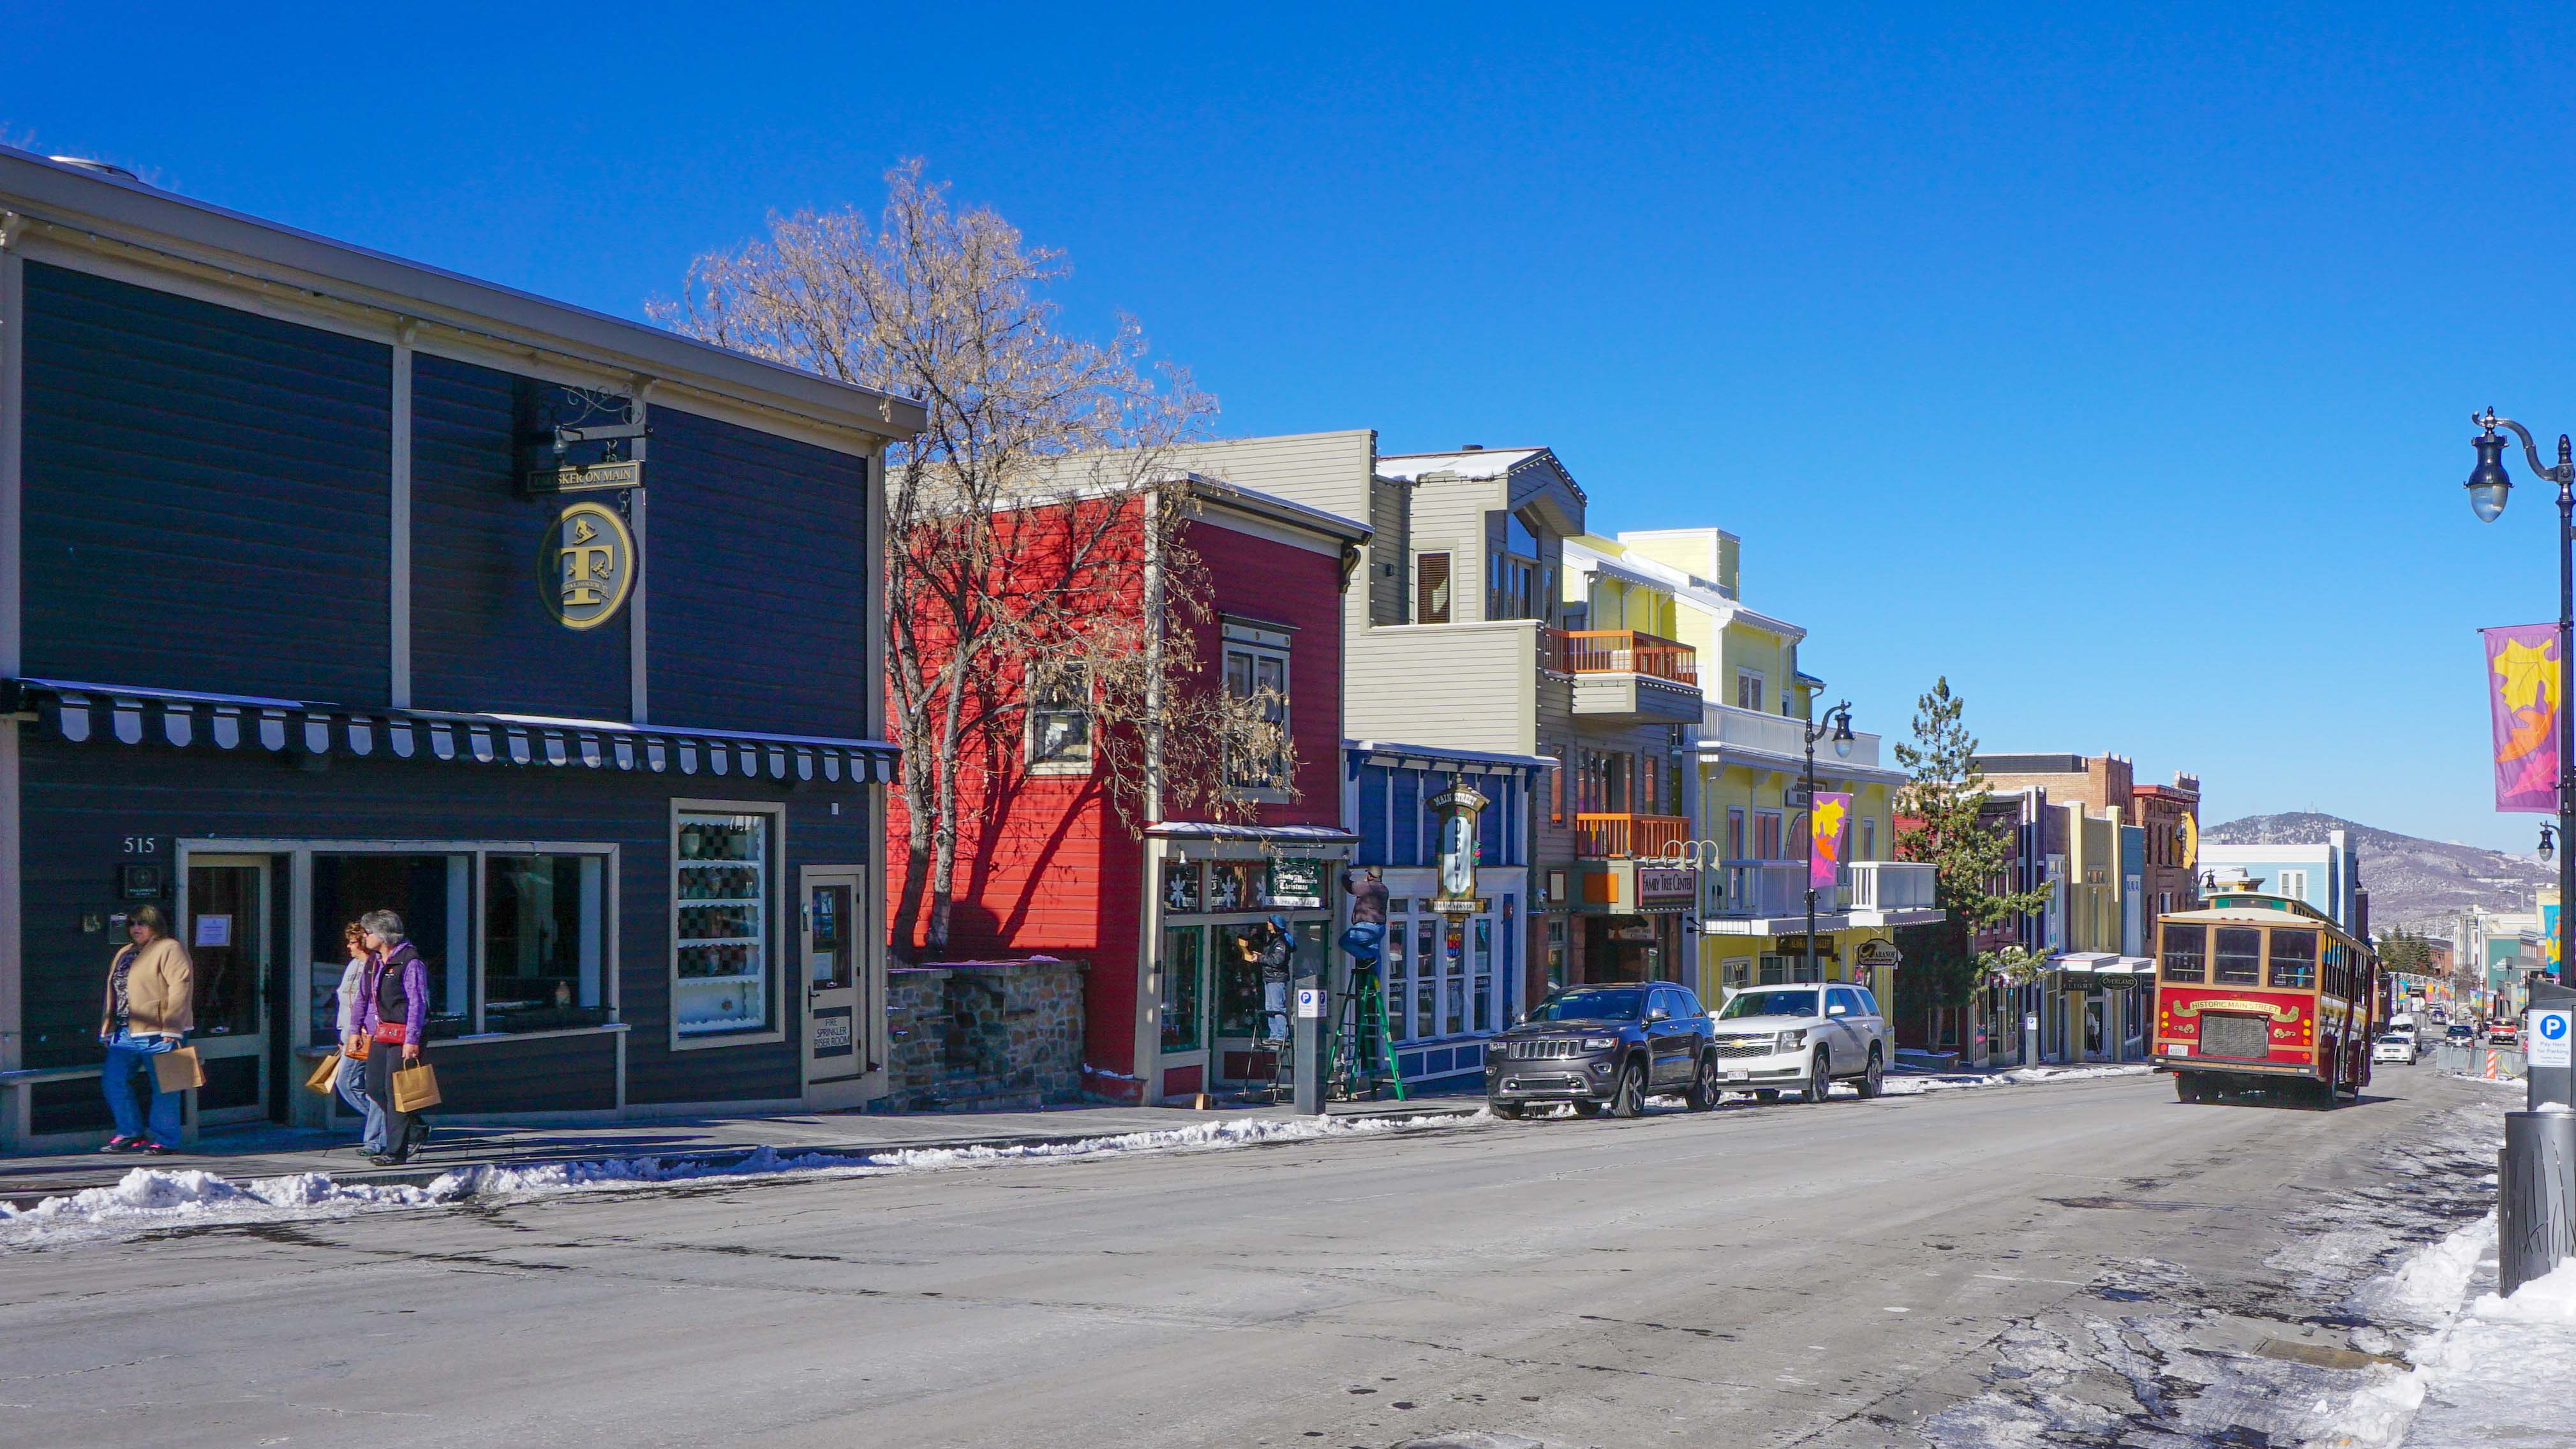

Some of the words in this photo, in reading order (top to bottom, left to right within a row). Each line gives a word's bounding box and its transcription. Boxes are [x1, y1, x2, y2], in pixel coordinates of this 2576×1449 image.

[585, 472, 600, 482] ON
[603, 469, 631, 480] MAIN
[1434, 793, 1452, 806] MAIN
[1454, 792, 1478, 806] STREET
[124, 837, 154, 854] 515
[1642, 874, 1660, 891] FAMILY
[1660, 874, 1672, 891] TREE
[1672, 873, 1693, 891] CENTER
[1433, 900, 1476, 911] DELICATESSEN
[2191, 1000, 2226, 1009] HISTORIC
[2250, 1003, 2279, 1013] STREET
[826, 1018, 837, 1026] FIRE
[2546, 1018, 2561, 1036] P
[817, 1026, 847, 1038] SPRINKLER
[831, 1035, 850, 1045] ROOM
